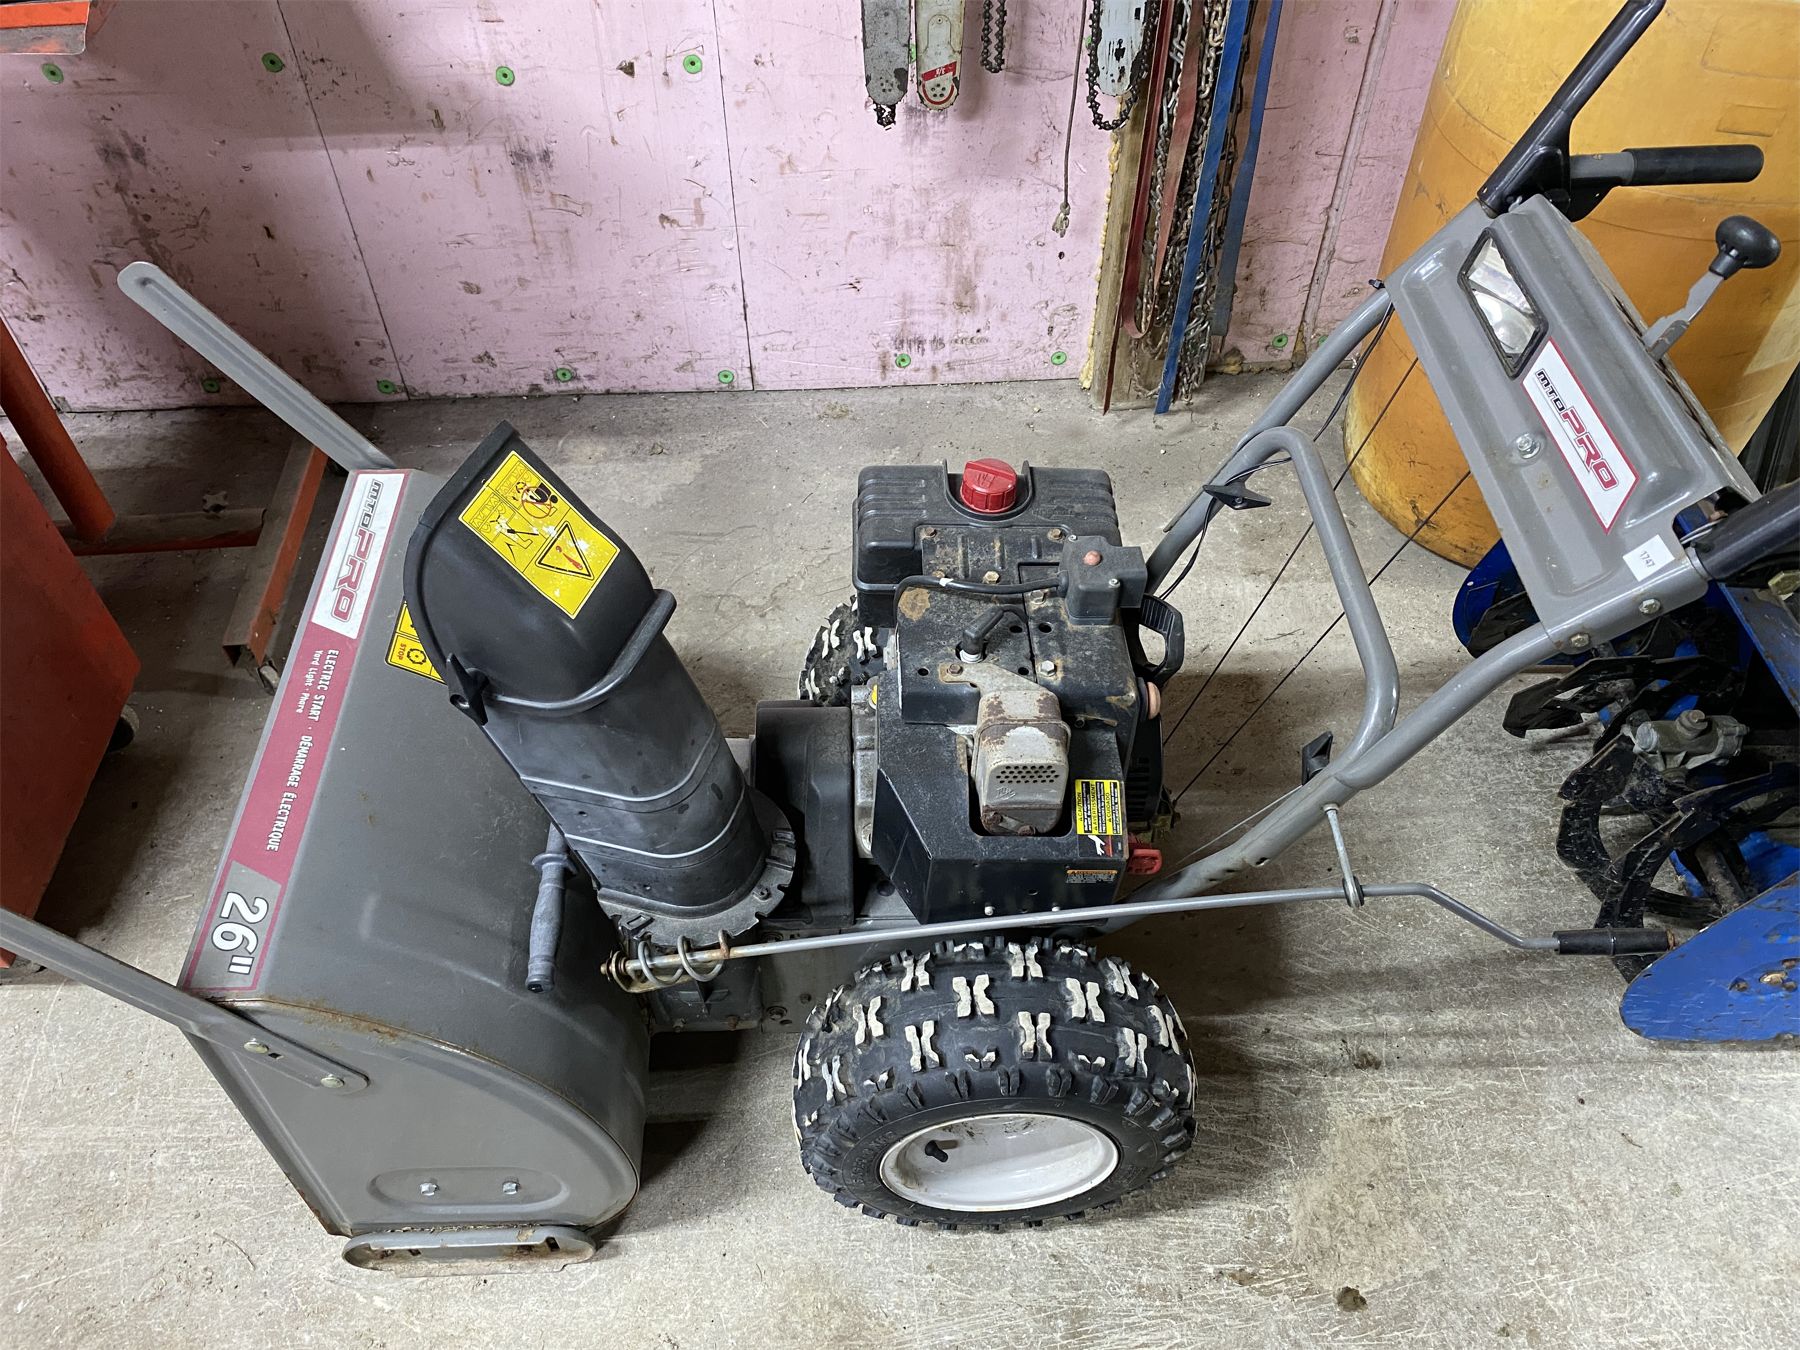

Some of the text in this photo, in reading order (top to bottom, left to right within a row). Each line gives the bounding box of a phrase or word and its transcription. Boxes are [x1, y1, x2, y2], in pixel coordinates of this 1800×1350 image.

[1561, 406, 1619, 491] PRO
[331, 529, 376, 622] PRO
[1640, 550, 1655, 568] 1747
[295, 650, 323, 713] Yard Light Phare
[397, 643, 406, 660] STOP
[266, 649, 339, 851] ELECTRIC START DÉMARRAGE ÉLECTRIQUE
[211, 891, 269, 975] 26"
